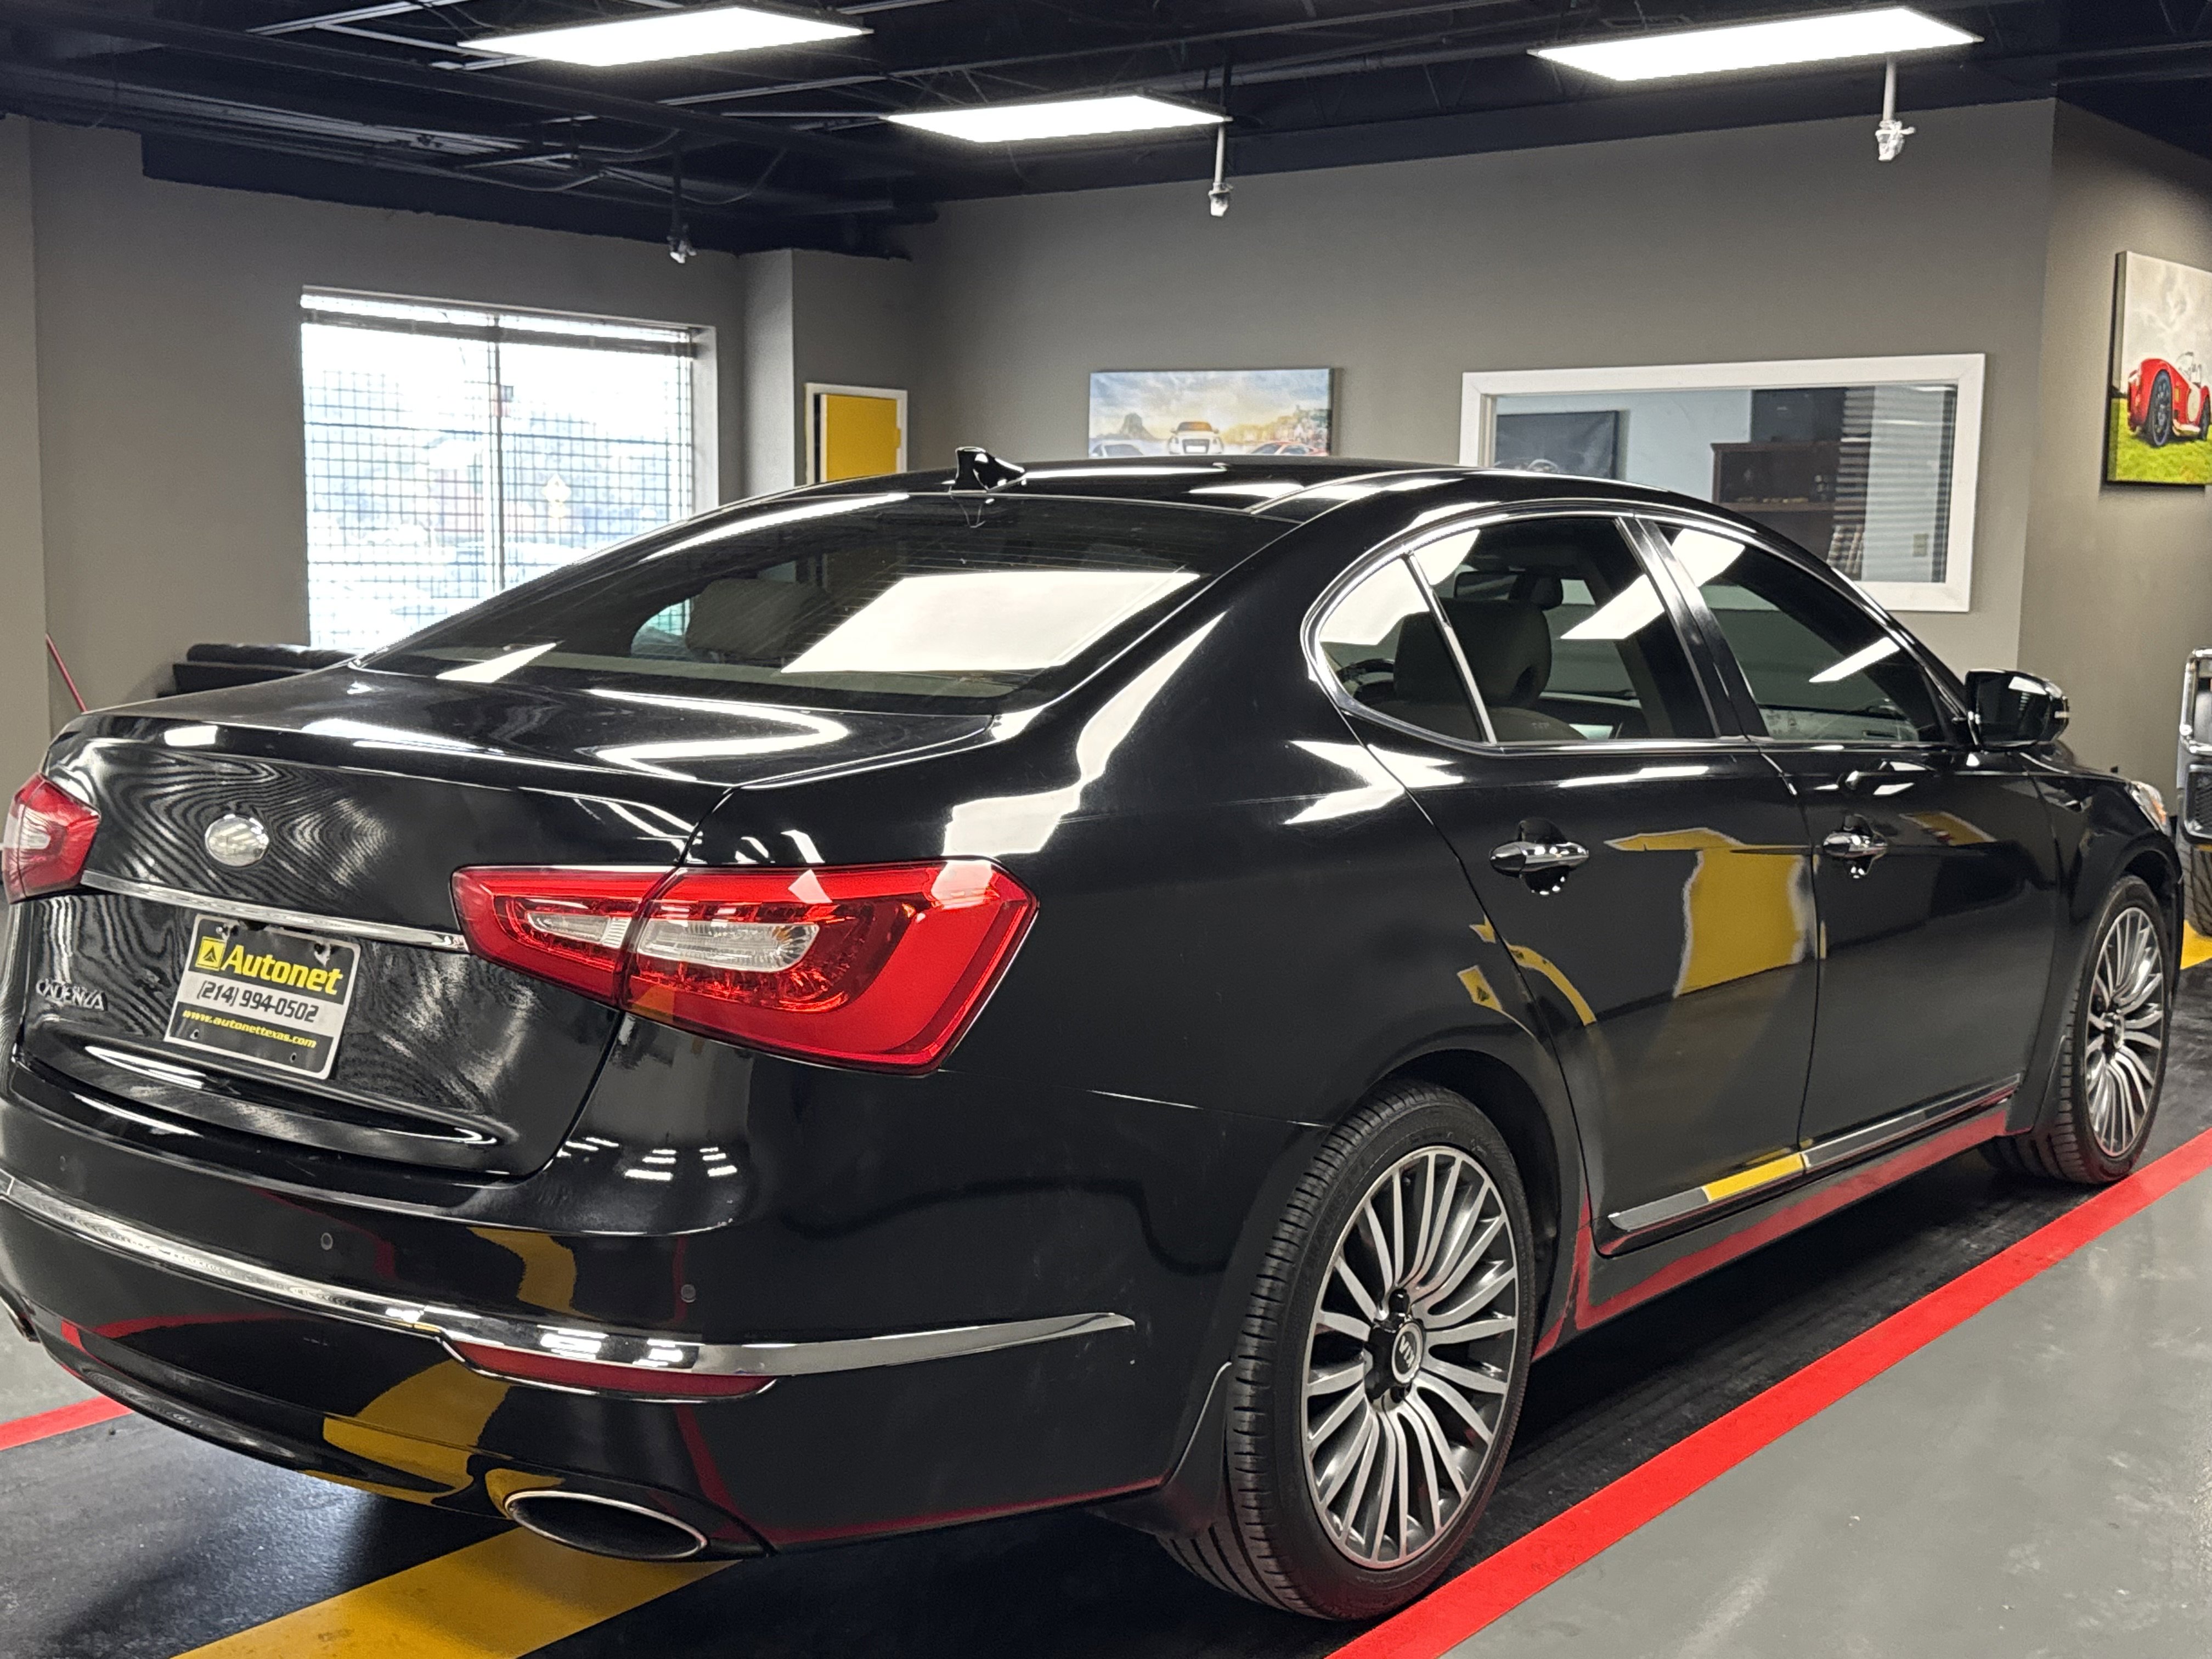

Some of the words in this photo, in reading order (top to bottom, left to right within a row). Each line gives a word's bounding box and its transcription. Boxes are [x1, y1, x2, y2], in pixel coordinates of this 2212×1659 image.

[221, 944, 343, 995] Autonet
[196, 980, 239, 1007] (214)
[239, 989, 319, 1023] 994-0502
[182, 1009, 317, 1048] www.autonettexas.com
